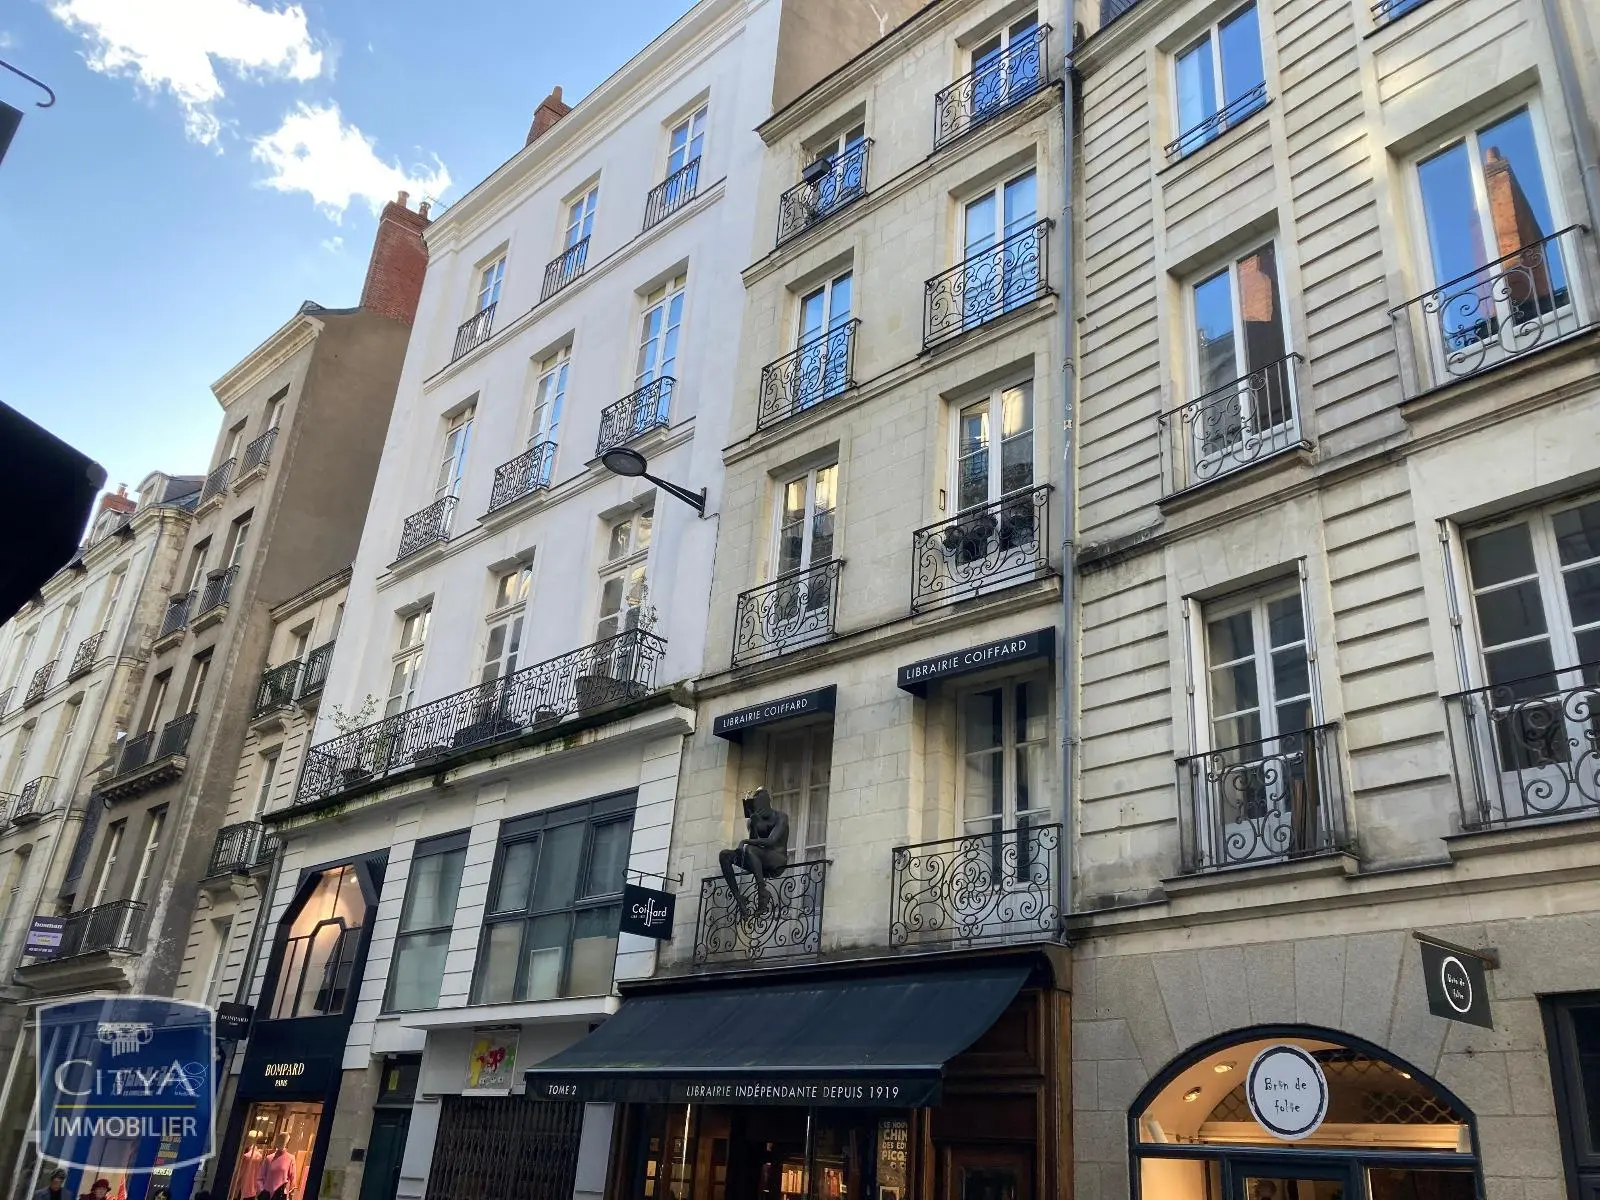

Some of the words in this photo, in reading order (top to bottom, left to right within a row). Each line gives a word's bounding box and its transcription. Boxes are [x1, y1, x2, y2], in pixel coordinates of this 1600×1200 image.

[905, 656, 960, 680] LIBRAIRIE
[964, 640, 1027, 664] COIFFARD
[723, 710, 761, 728] LIBRAIRIE
[763, 698, 808, 717] COIFFARD
[632, 897, 668, 928] Coiffard
[221, 1014, 249, 1023] BOMPARD
[264, 1062, 305, 1077] BOMPARD
[274, 1079, 289, 1087] PARIS
[548, 1085, 570, 1096] TOME
[571, 1085, 578, 1096] 2
[1264, 1077, 1289, 1092] Brin
[1295, 1077, 1307, 1091] de
[686, 1085, 732, 1098] LIBRAIRIE
[735, 1083, 818, 1099] INDÉPENDANTE
[823, 1086, 864, 1099] DEPUIS
[869, 1086, 900, 1100] 1919
[1274, 1099, 1301, 1116] folie
